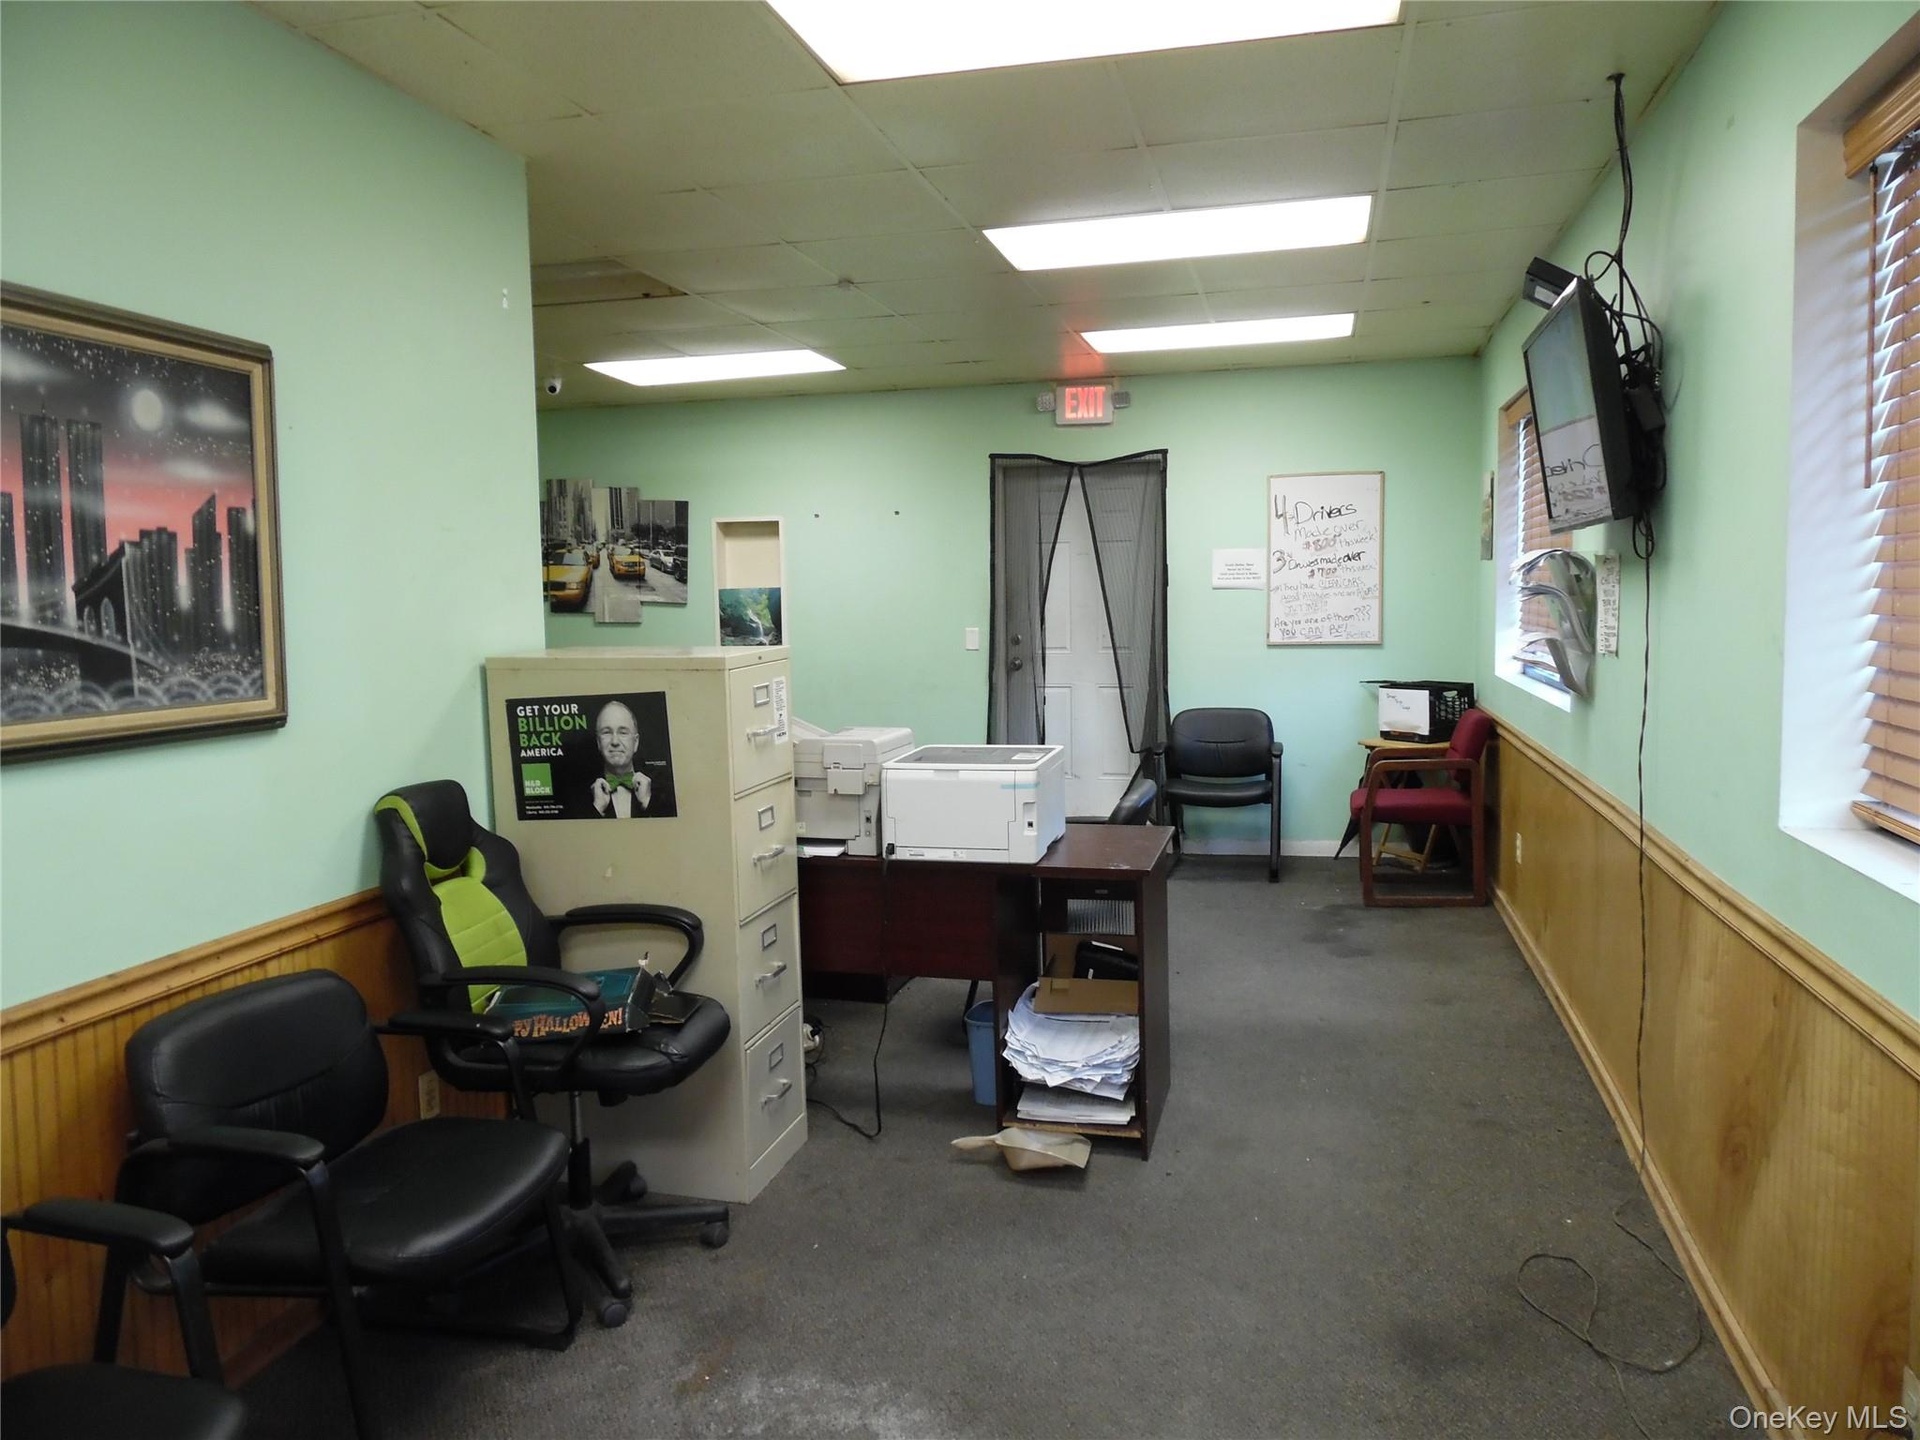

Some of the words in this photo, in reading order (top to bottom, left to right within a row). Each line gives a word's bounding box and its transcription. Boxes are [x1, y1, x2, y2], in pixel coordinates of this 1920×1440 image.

[1065, 386, 1106, 418] EXIT
[1342, 550, 1366, 562] over
[1274, 616, 1289, 628] Are
[1290, 618, 1302, 631] you
[1320, 613, 1332, 623] of
[516, 705, 540, 717] GET
[542, 703, 579, 716] YOUR
[517, 714, 588, 732] BILLION
[518, 732, 563, 747] BACK
[519, 747, 565, 757] AMERICA
[525, 786, 551, 794] BLOCK
